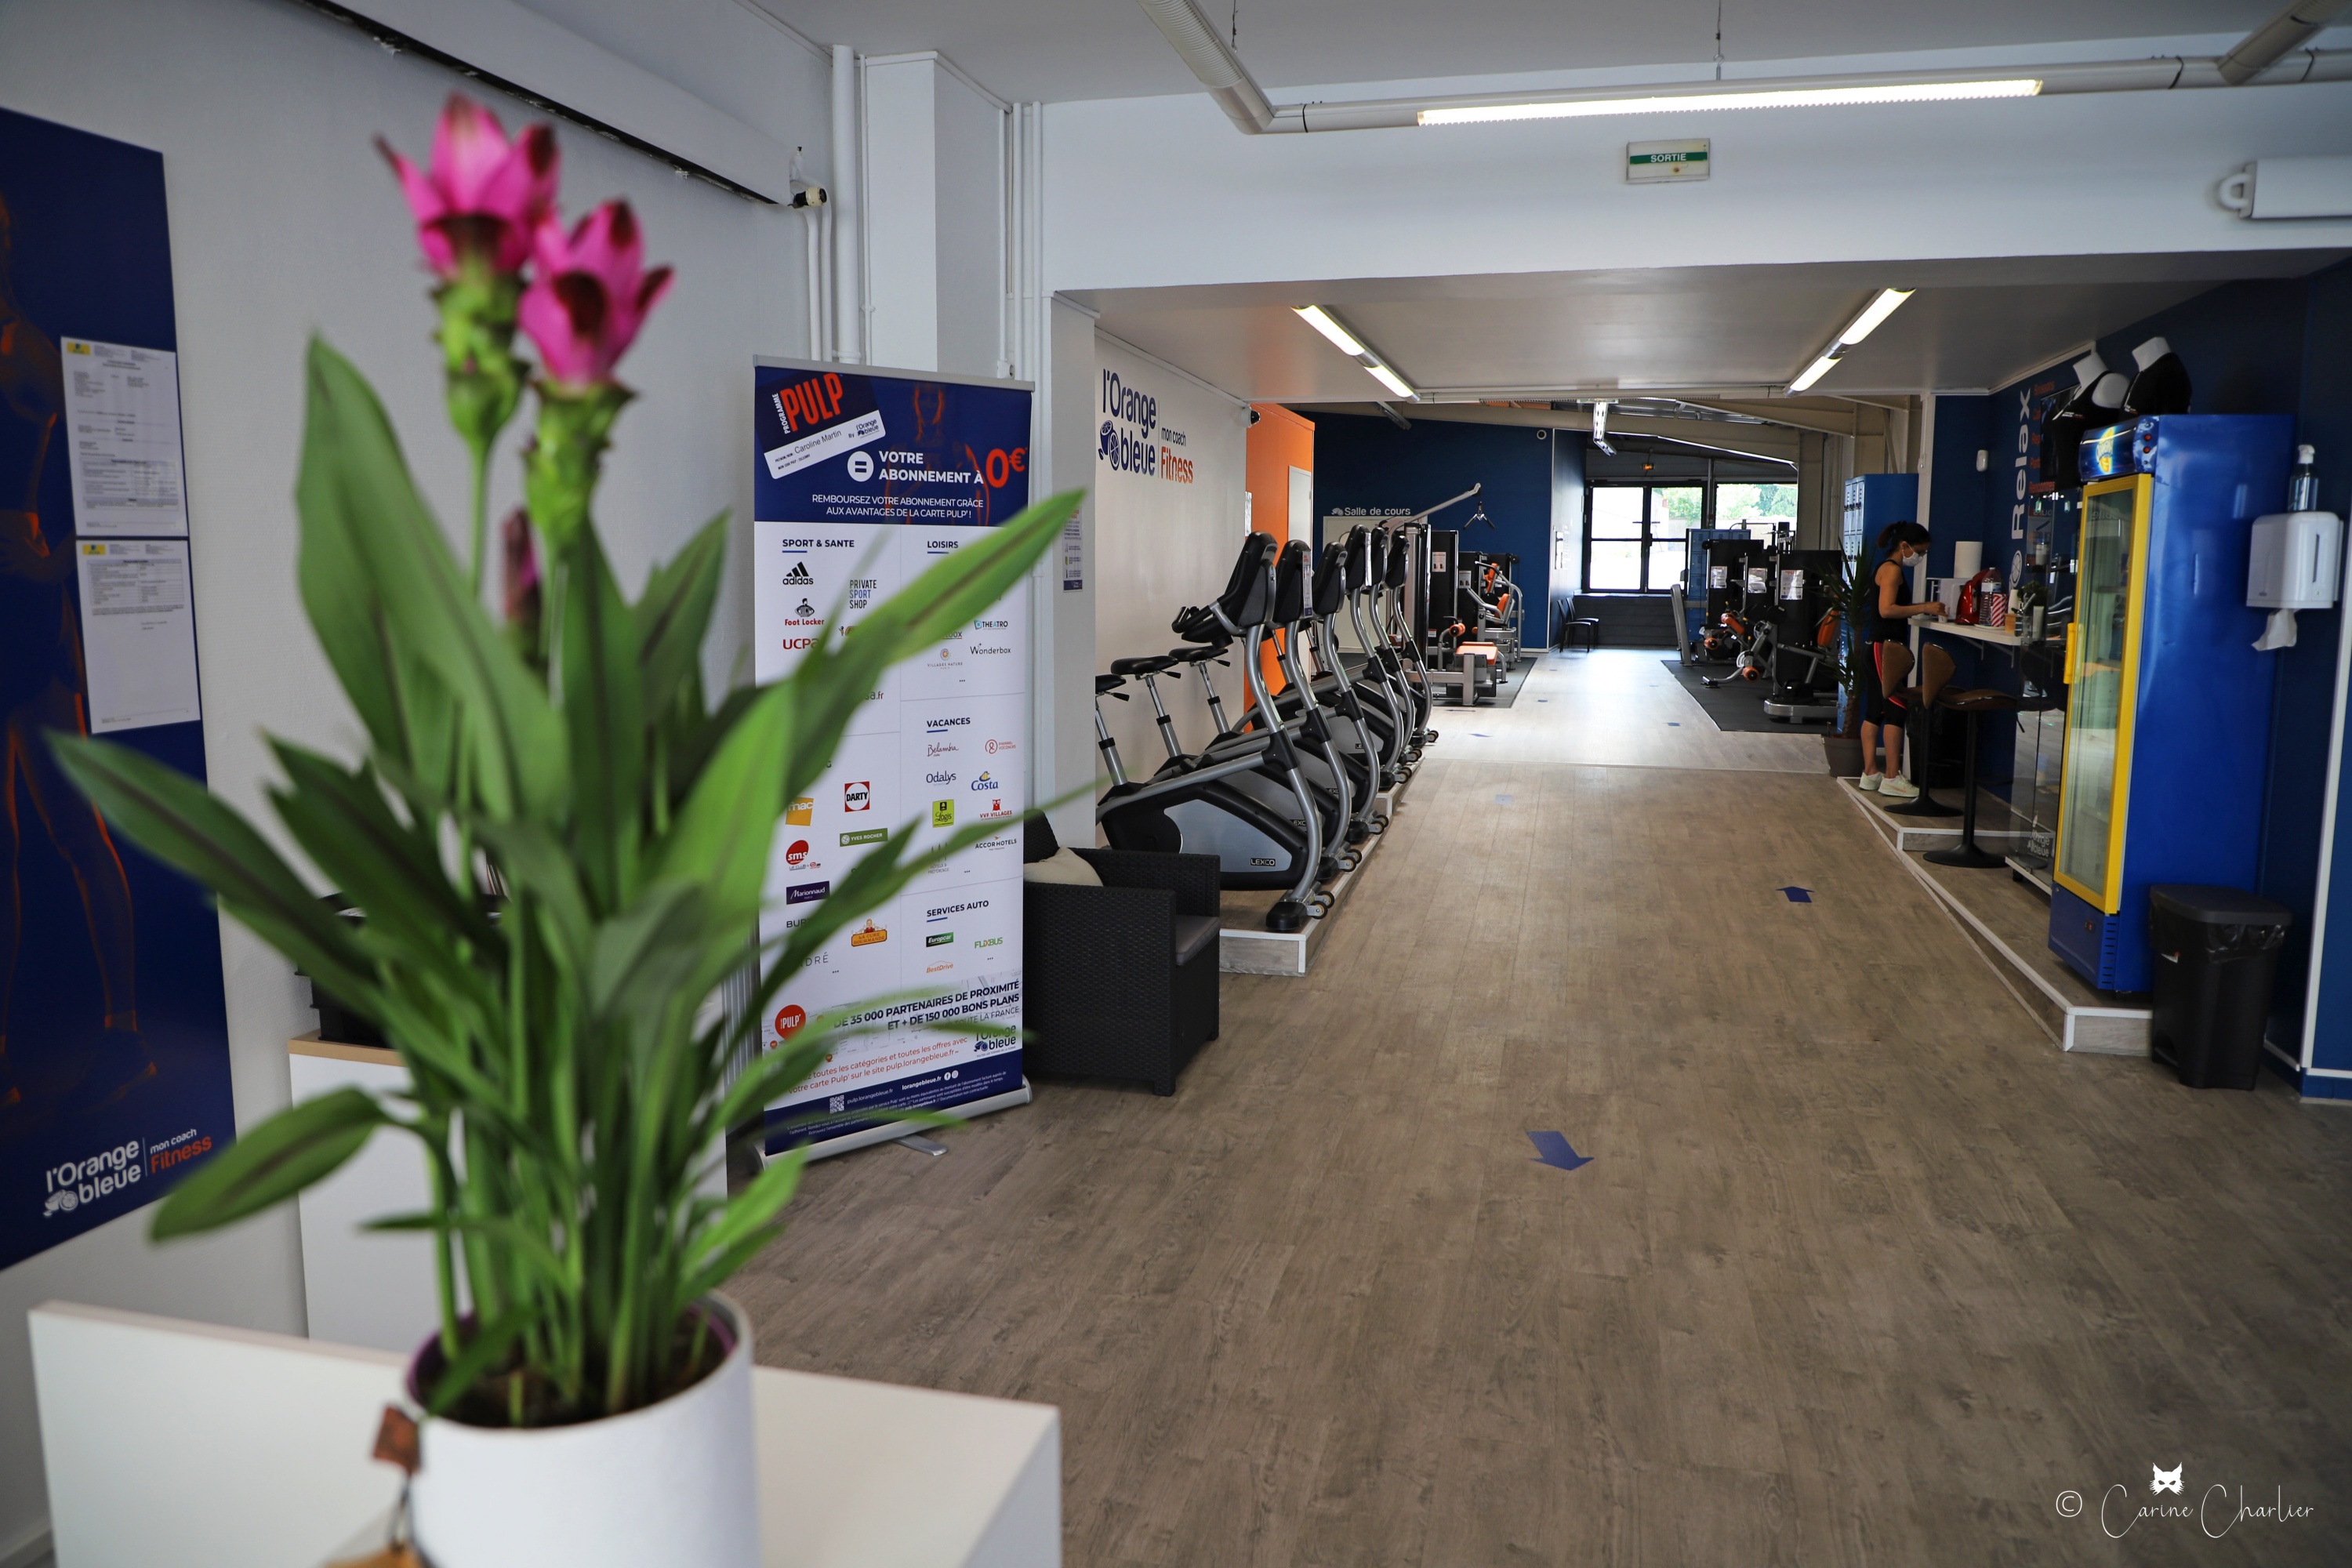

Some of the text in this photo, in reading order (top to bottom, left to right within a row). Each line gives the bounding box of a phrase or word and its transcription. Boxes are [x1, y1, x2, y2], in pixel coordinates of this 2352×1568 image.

[1650, 154, 1686, 163] SORTIE
[780, 372, 844, 432] PULP
[1102, 368, 1156, 439] l'Orange
[771, 393, 791, 434] PROGRAMME
[856, 419, 877, 430] l'Orange
[794, 430, 842, 454] Caroline Martin
[1161, 426, 1186, 447] mon coach
[879, 451, 924, 464] VOTRE
[1120, 427, 1156, 477] bleue
[1161, 446, 1193, 485] Fitness
[2011, 388, 2031, 539] Relax
[879, 469, 971, 484] ABONNEMENT
[974, 470, 984, 485] À
[812, 494, 984, 508] REMBOURSEZ VOTRE ABONNEMENT GRÂCE
[826, 507, 845, 516] AUX
[845, 508, 895, 517] AVANTAGES
[896, 509, 908, 517] DE
[909, 509, 920, 517] LA
[920, 509, 946, 518] CARTE
[1345, 507, 1367, 516] Salle
[1370, 507, 1381, 516] de
[782, 576, 814, 585] adidas
[849, 579, 877, 589] PRIVATE
[849, 590, 871, 599] SPORT
[849, 600, 867, 609] SHOP
[970, 646, 1011, 655] Wonderbox
[927, 717, 971, 728] VACANCES
[926, 771, 956, 785] Odalys
[971, 780, 999, 791] Costa
[846, 792, 868, 801] DARTY
[935, 811, 952, 822] Logis
[788, 852, 808, 861] sms
[790, 887, 826, 899] Marionnaud
[927, 900, 989, 917] SERVICES AUTO
[786, 919, 809, 928] BUR
[928, 935, 952, 944] Europcar
[802, 952, 829, 967] DRÉ
[927, 964, 954, 973] BestDrive
[851, 1014, 862, 1025] 35
[864, 1010, 884, 1022] 000
[886, 995, 953, 1017] PARTENAIRES
[955, 992, 968, 1002] DE
[970, 978, 1019, 999] PROXIMITÉ
[887, 1020, 900, 1030] ET
[909, 1014, 924, 1025] DE
[925, 1011, 940, 1022] 150
[942, 1007, 960, 1018] 000
[962, 1000, 988, 1014] BONS
[990, 993, 1019, 1007] PLANS
[980, 1013, 989, 1022] LA
[991, 1006, 1019, 1018] FRANCE
[989, 1036, 1017, 1050] bleue
[813, 1068, 837, 1079] toutes
[851, 1055, 888, 1069] catégories
[898, 1049, 920, 1058] toutes
[932, 1041, 951, 1051] offres
[952, 1037, 968, 1046] avec
[789, 1084, 808, 1094] votre
[810, 1079, 829, 1089] carte
[847, 1076, 942, 1104] pulp.lorangebleue.fr lorangebleue.fr
[150, 1128, 197, 1155] mon coach
[151, 1136, 212, 1174] Fitness
[45, 1140, 140, 1192] l'Orange
[78, 1163, 142, 1203] bleue
